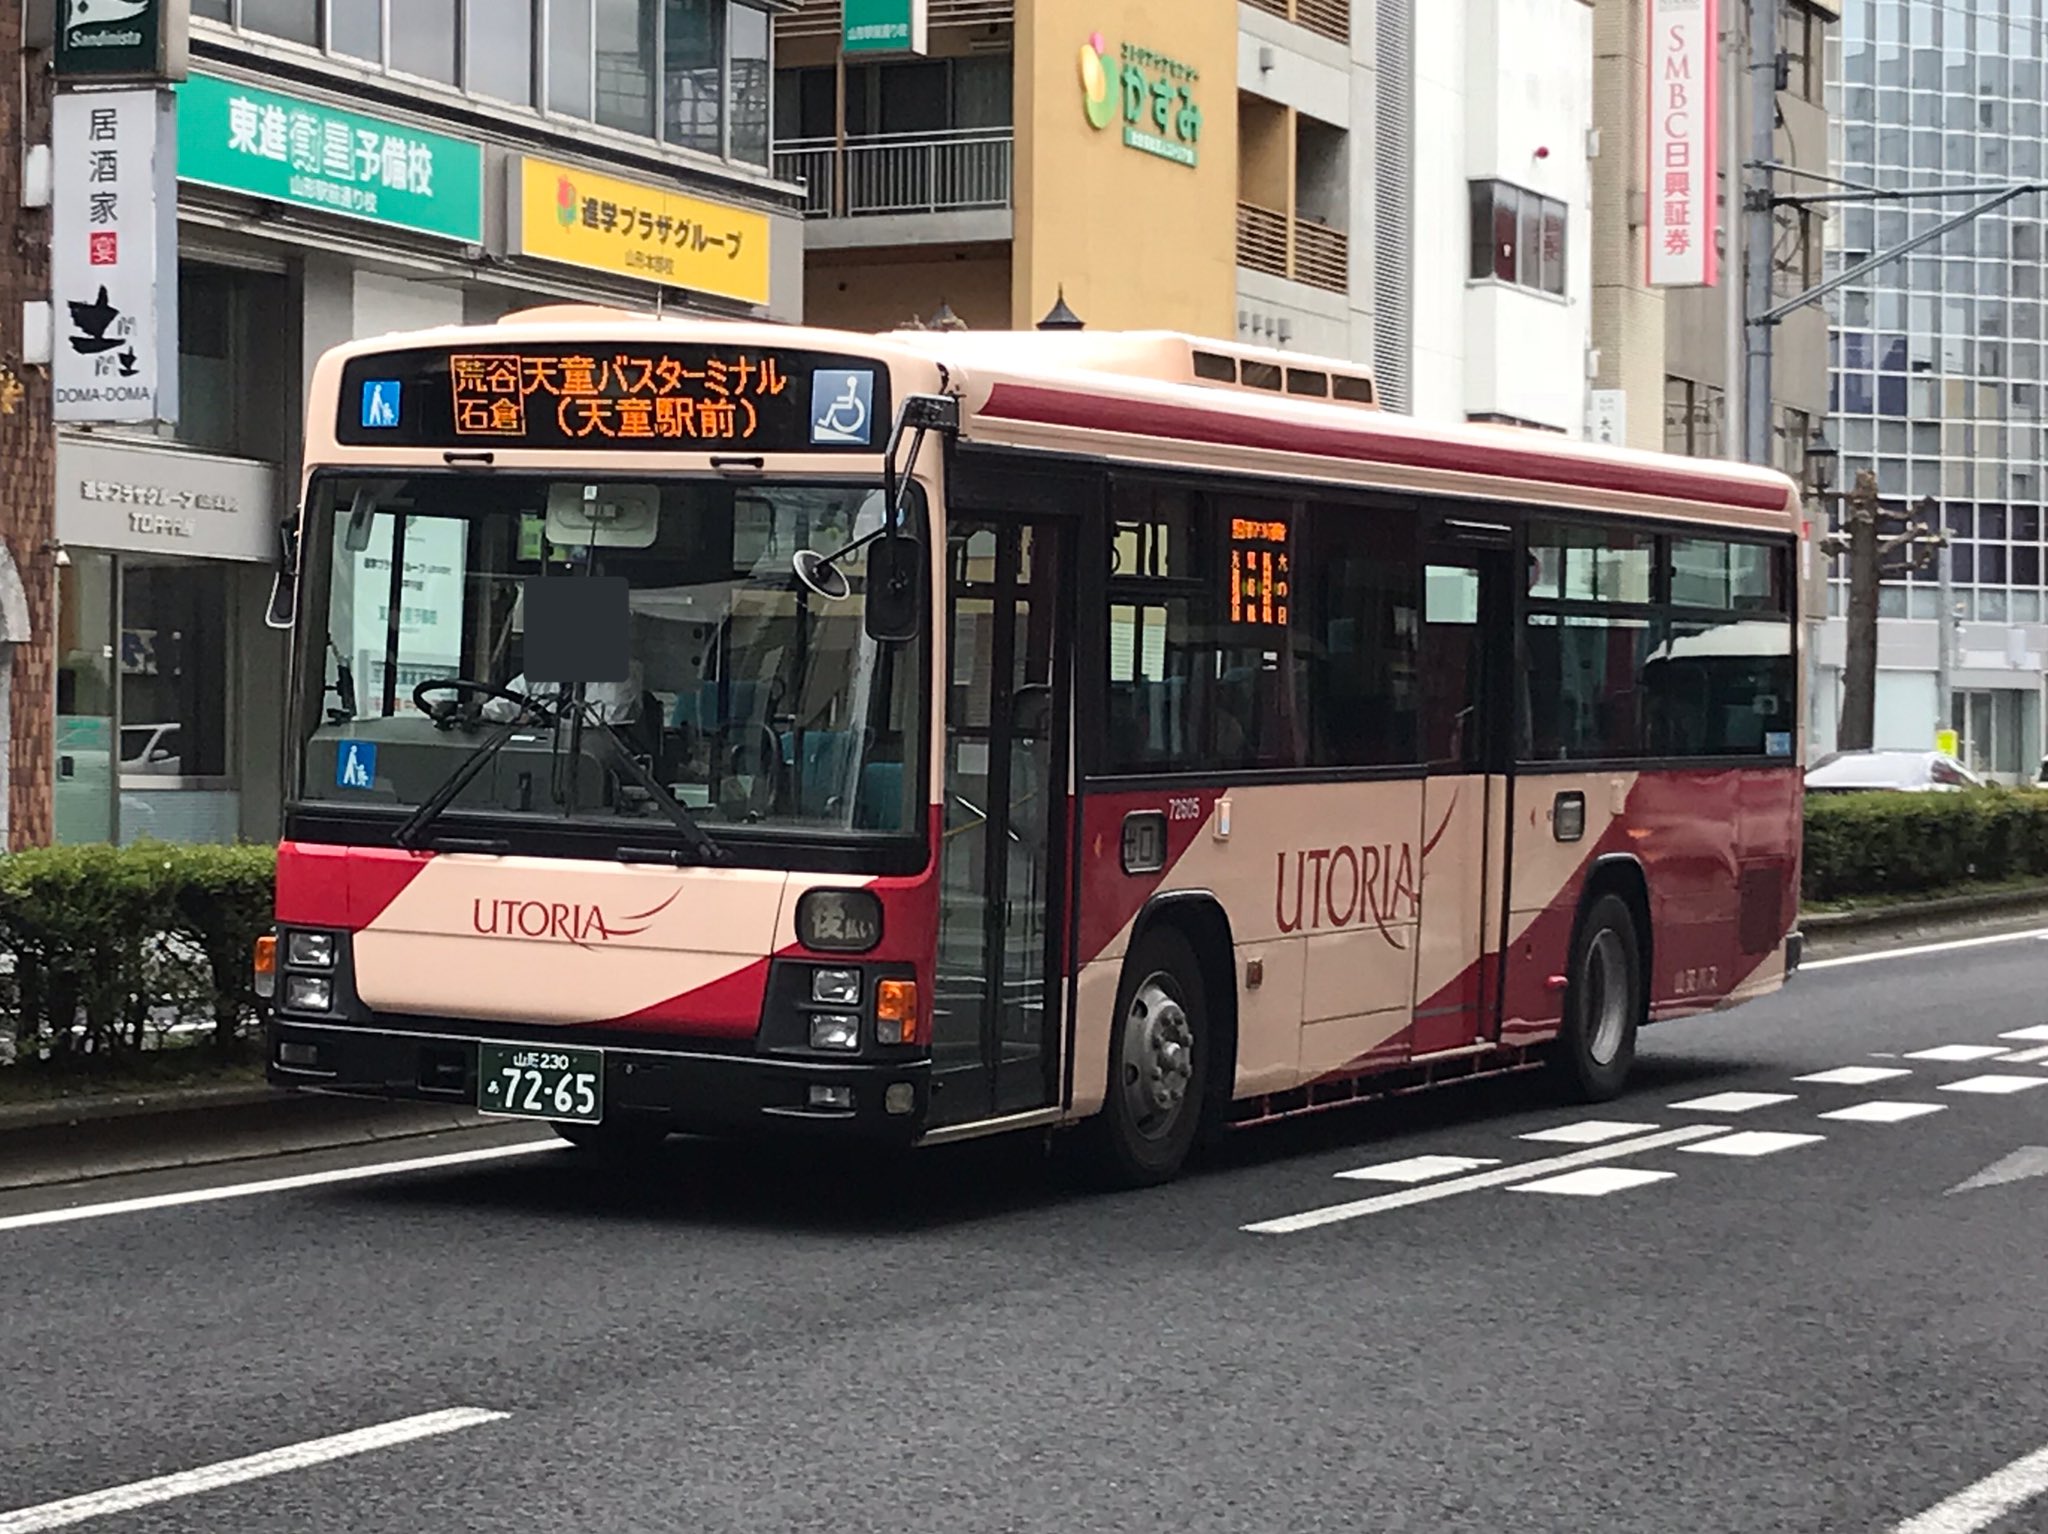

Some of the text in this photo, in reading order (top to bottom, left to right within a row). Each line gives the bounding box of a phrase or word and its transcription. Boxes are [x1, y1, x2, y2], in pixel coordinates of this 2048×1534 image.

[1120, 65, 1203, 142] かすみ
[89, 108, 118, 224] 居酒家
[1664, 25, 1691, 256] SMBC日興証券
[582, 197, 743, 260] 進学プラザグループ
[56, 388, 150, 403] DOMA-DOMA
[521, 355, 788, 395] 天童バスターミナル
[474, 898, 610, 953] UTORIA
[1275, 842, 1420, 950] UTORIA
